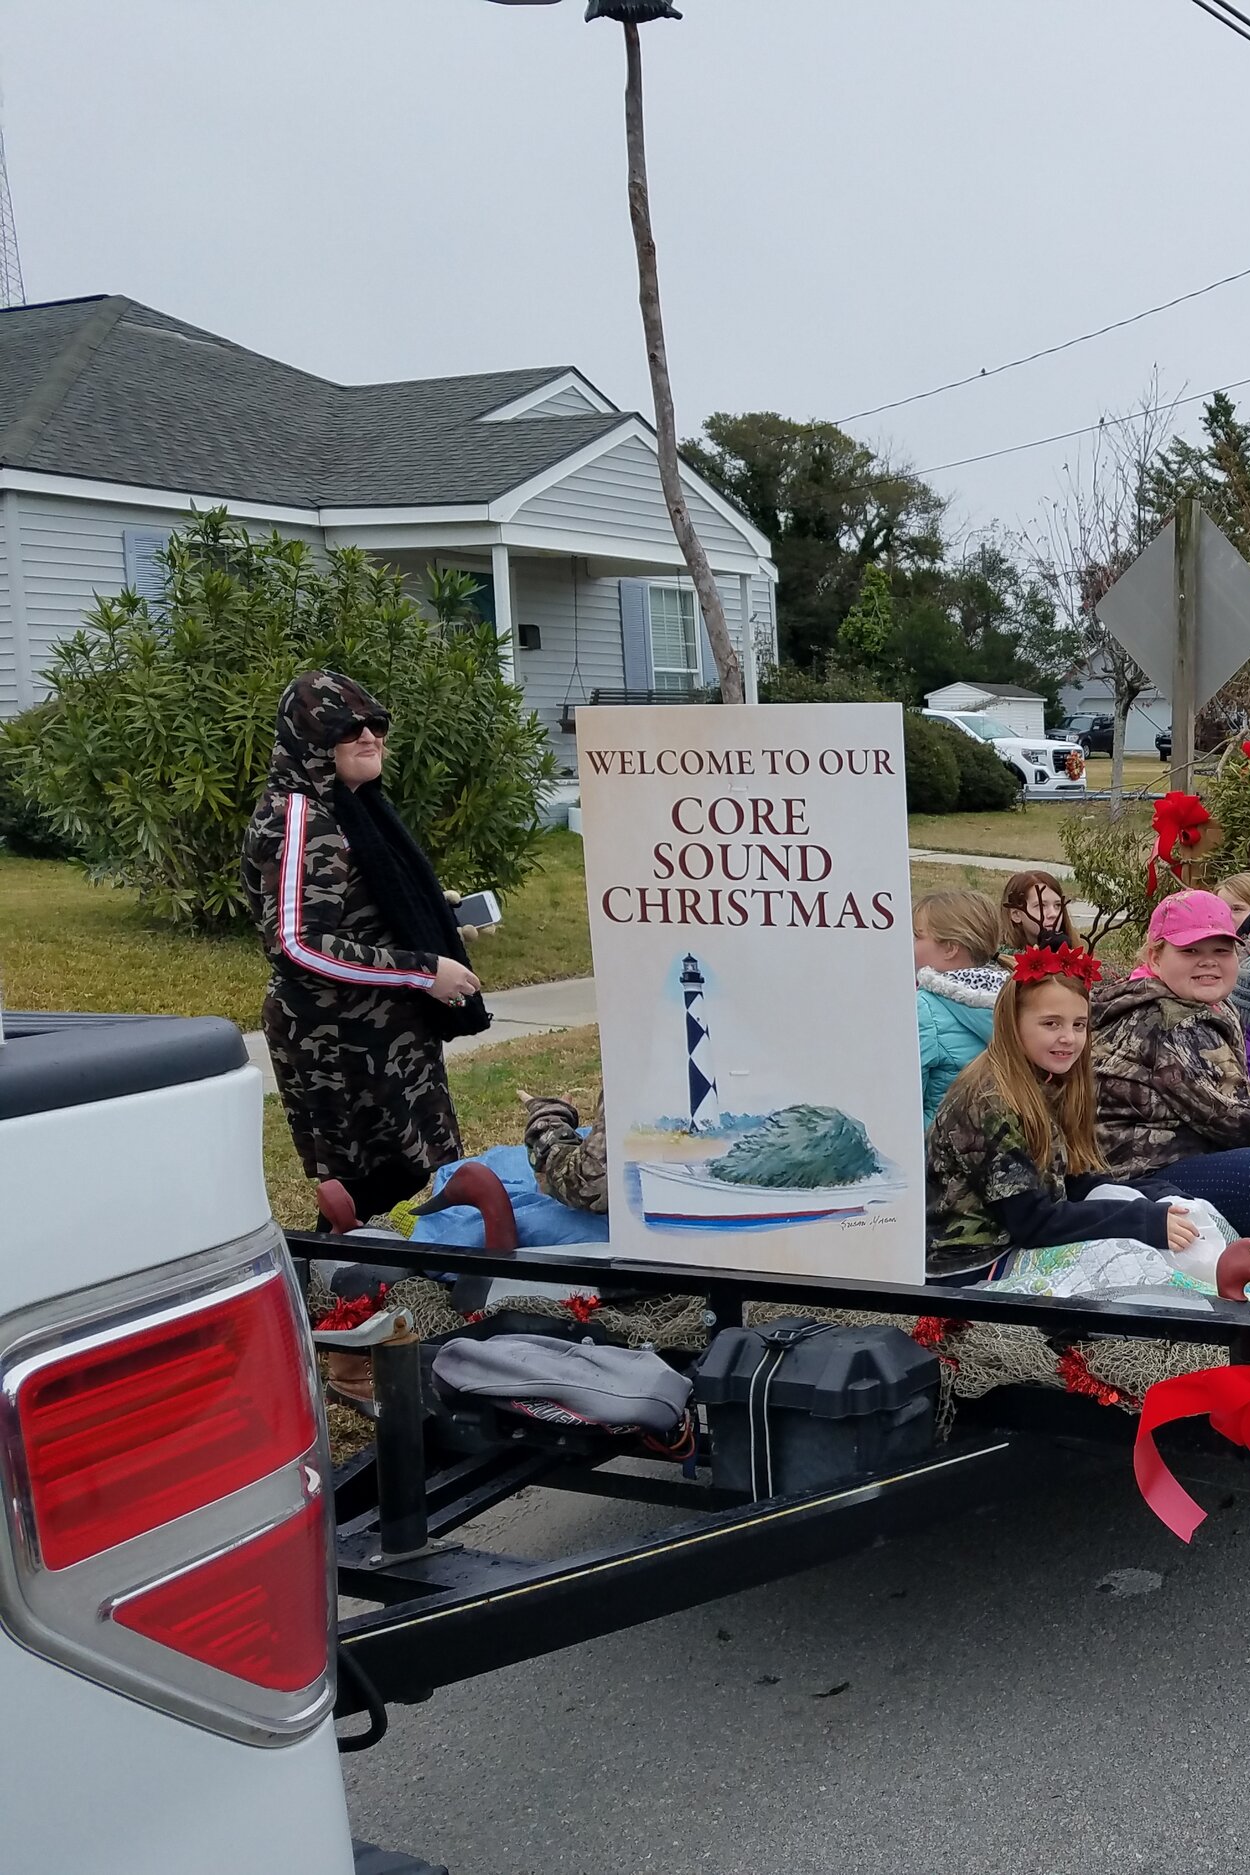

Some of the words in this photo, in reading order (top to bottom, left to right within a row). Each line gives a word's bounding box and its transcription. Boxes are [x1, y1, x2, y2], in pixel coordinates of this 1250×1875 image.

[585, 750, 755, 775] WELCOME
[762, 750, 809, 775] TO
[819, 749, 896, 775] OUR
[671, 797, 810, 836] CORE
[653, 842, 832, 882] SOUND
[602, 886, 895, 930] CHRISTMAS
